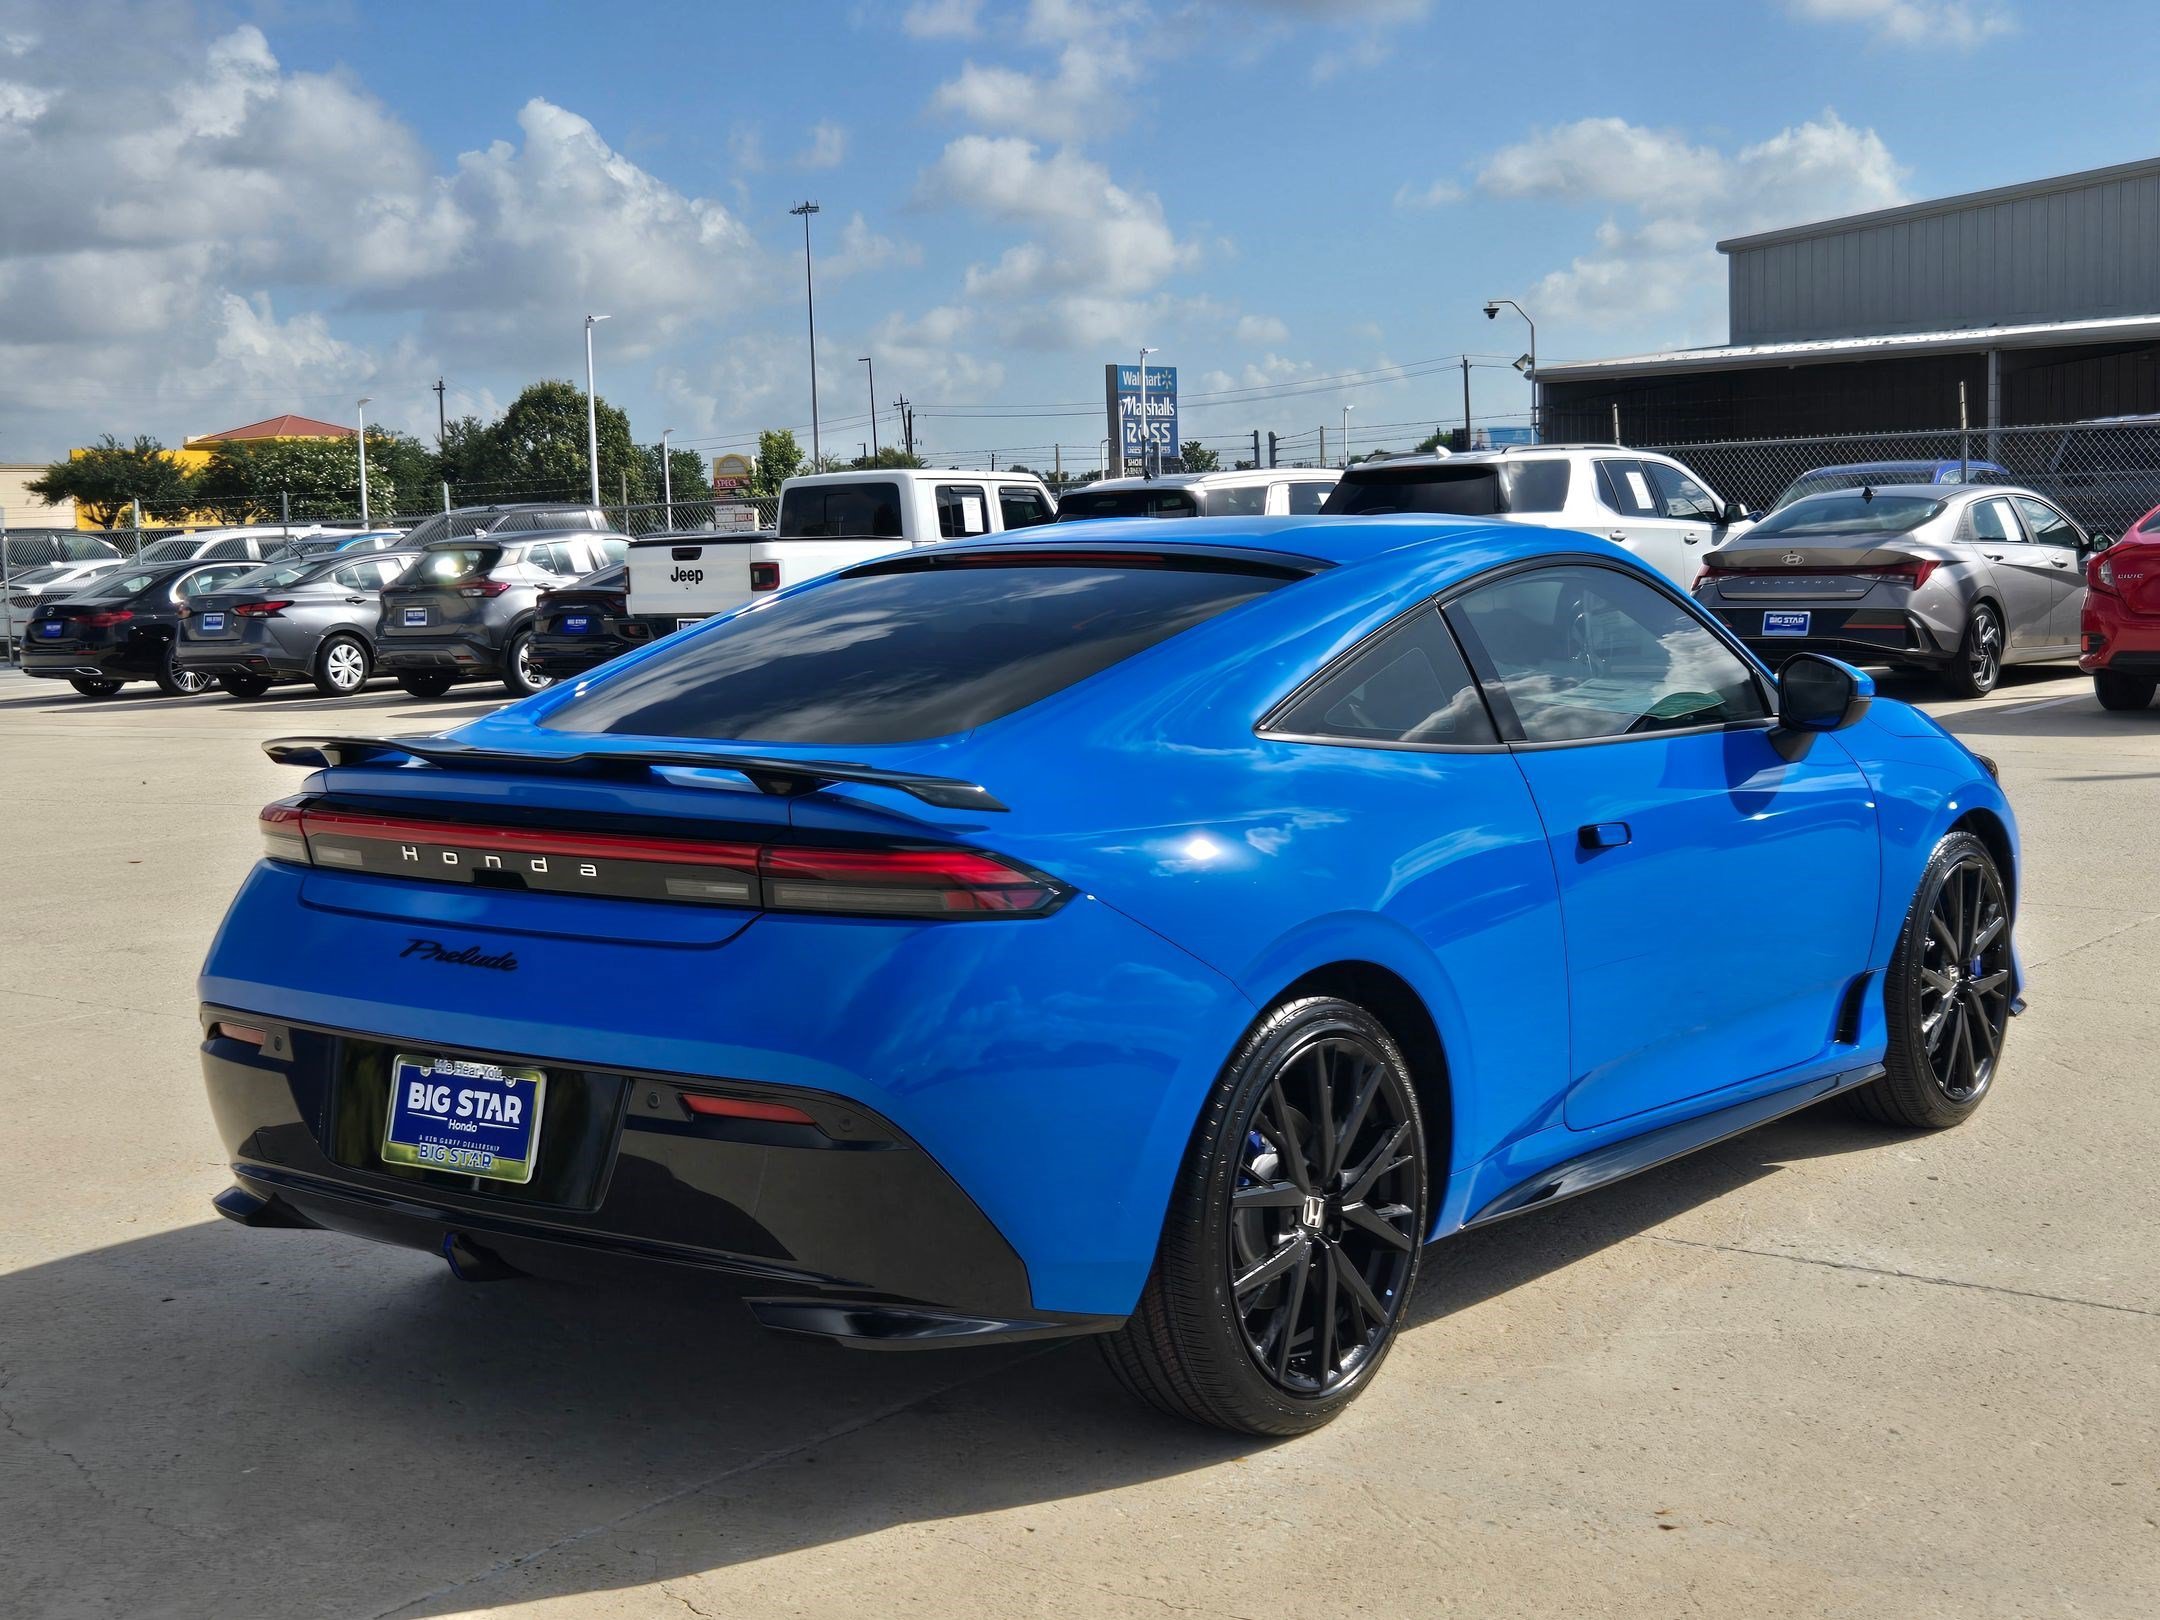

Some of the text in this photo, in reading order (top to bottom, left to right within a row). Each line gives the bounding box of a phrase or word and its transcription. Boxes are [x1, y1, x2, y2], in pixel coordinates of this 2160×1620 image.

[1122, 396, 1175, 416] Mashalls
[670, 566, 704, 585] Jeep
[1769, 616, 1805, 624] BIG STAR
[401, 845, 598, 877] Honda
[400, 938, 519, 972] Prelude
[407, 1081, 523, 1124] BIG STAR
[448, 1118, 478, 1133] Honda
[418, 1142, 494, 1169] BIG STAR
[463, 1141, 500, 1152] DEALERSHIP
